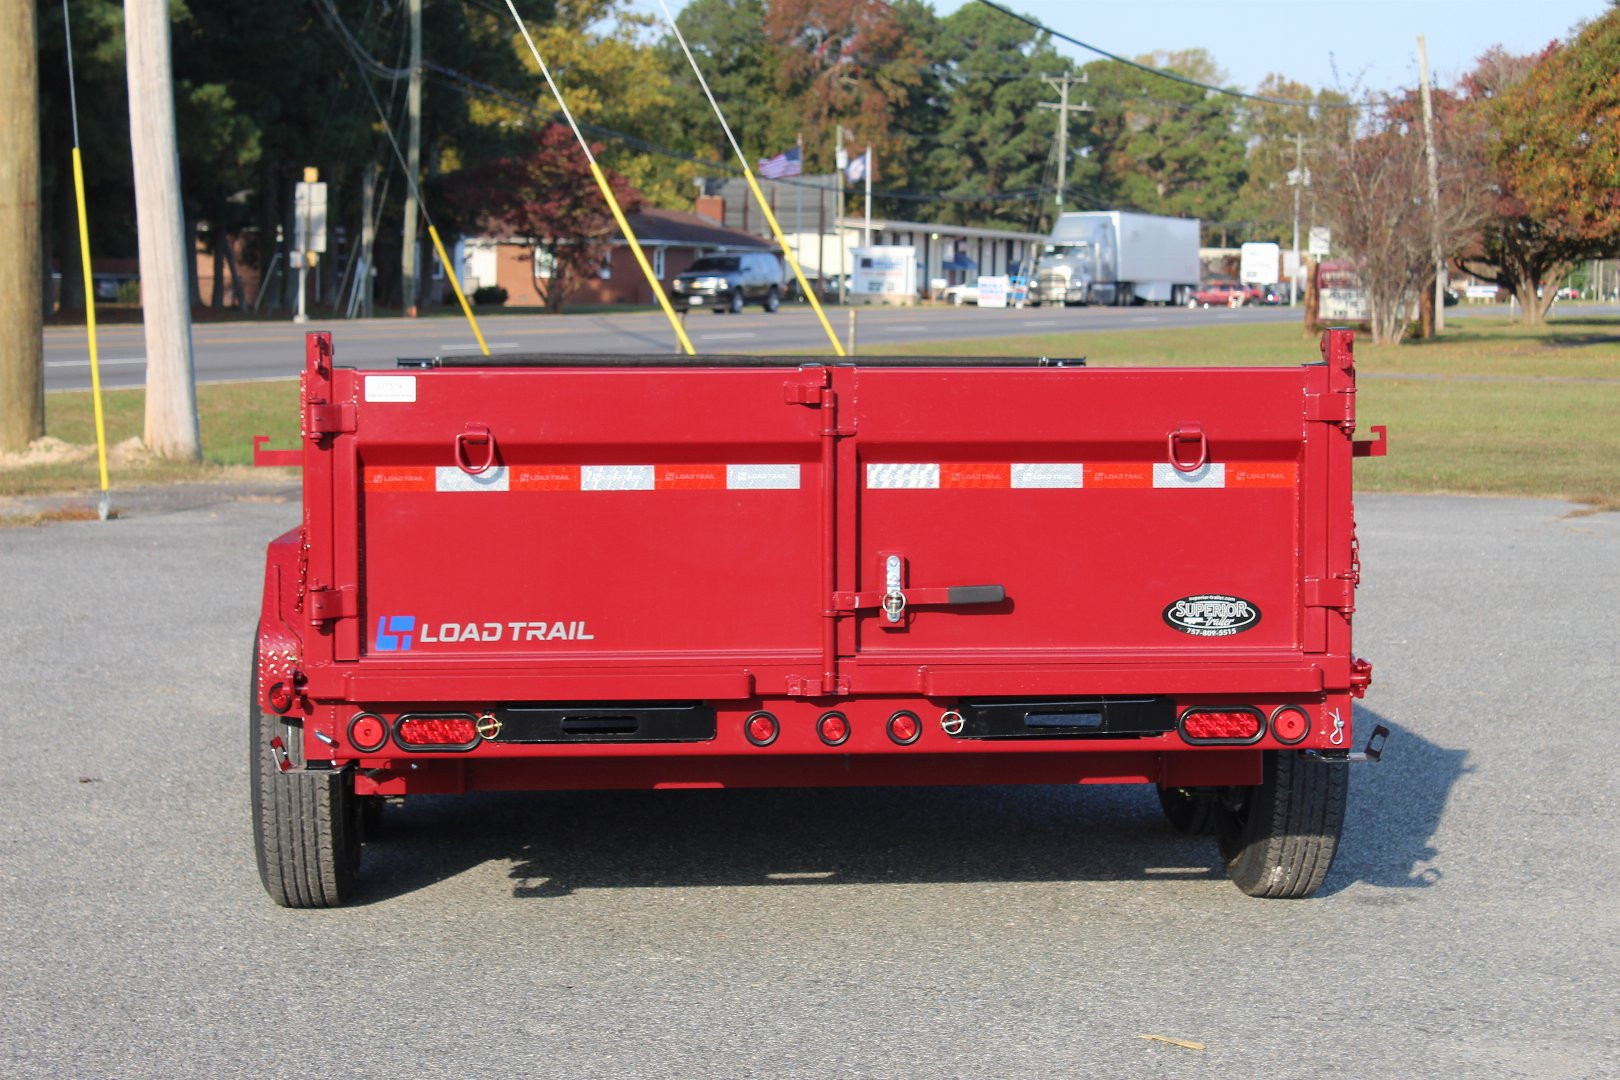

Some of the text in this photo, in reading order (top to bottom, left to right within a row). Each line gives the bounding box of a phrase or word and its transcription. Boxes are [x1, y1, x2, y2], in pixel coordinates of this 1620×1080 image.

[1175, 600, 1249, 618] SUPERIOR
[420, 623, 503, 643] LOAD
[507, 621, 594, 641] TRAIL
[1186, 628, 1237, 636] 757-809-5515
